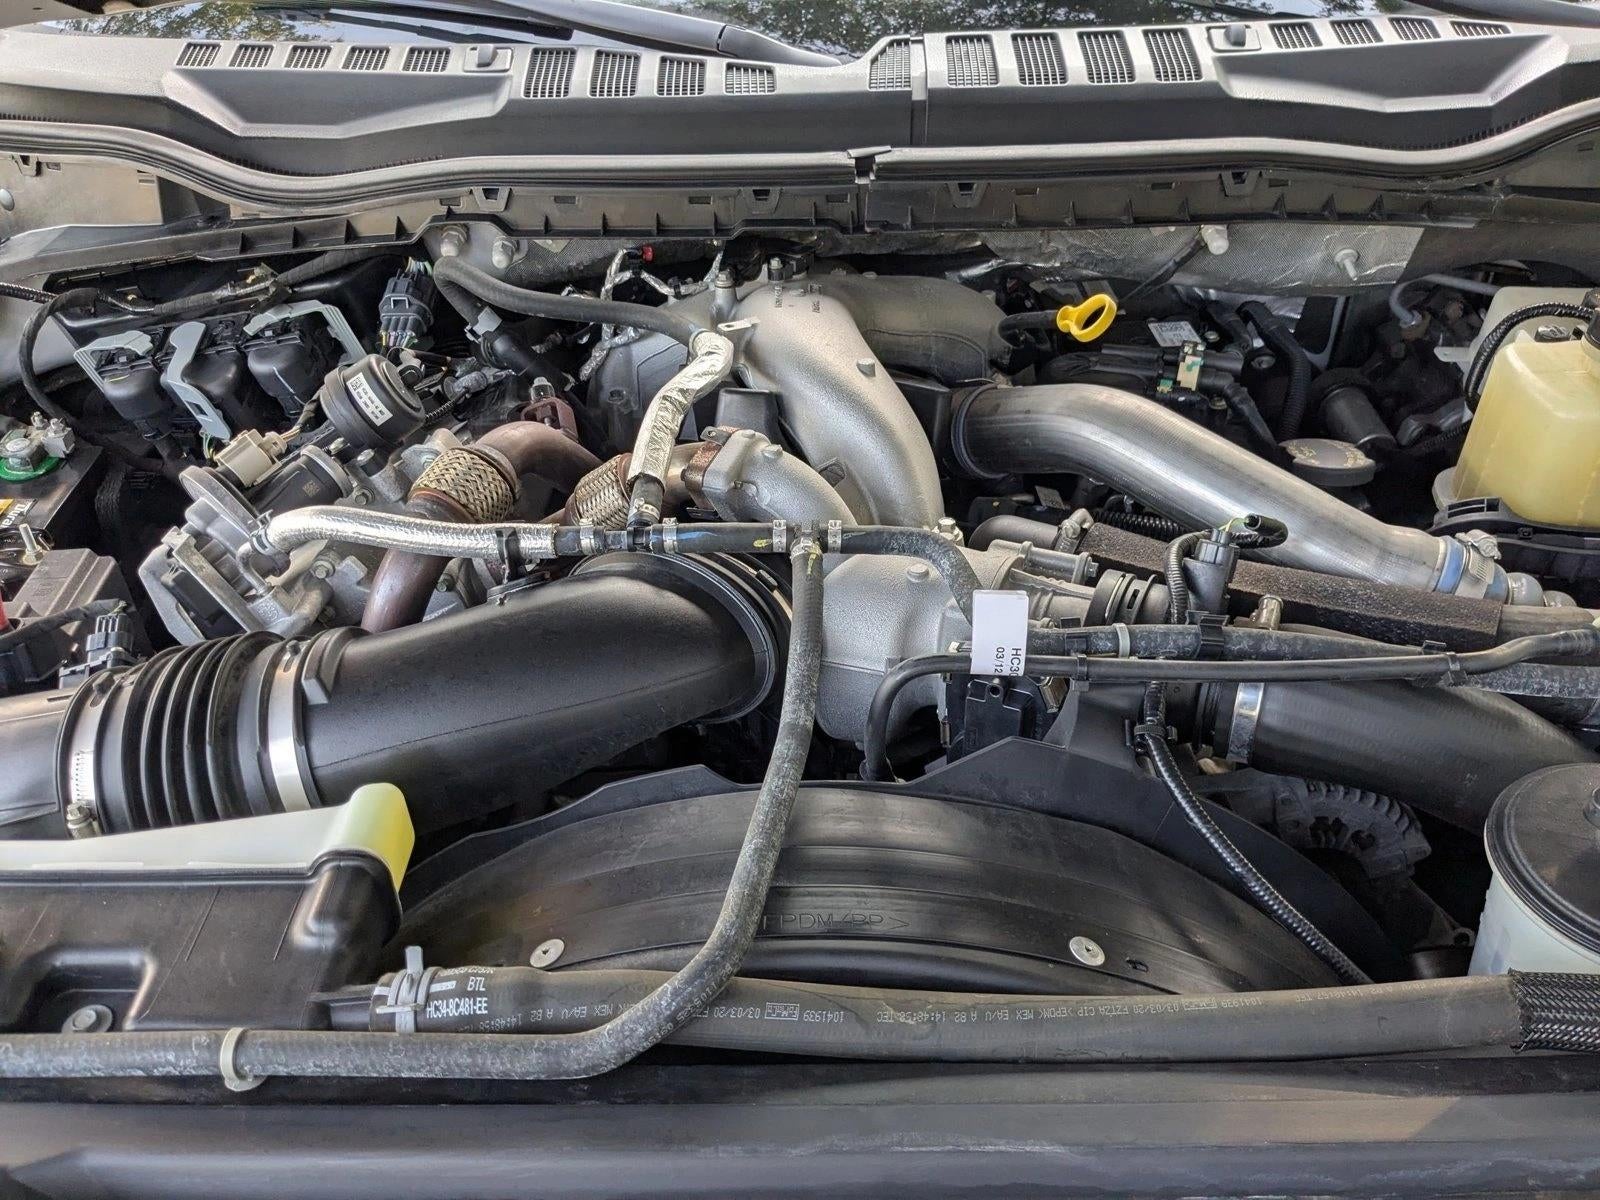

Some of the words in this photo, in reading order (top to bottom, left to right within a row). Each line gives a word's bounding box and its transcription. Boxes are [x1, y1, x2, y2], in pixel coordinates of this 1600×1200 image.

[994, 646, 1006, 674] 03/12
[466, 976, 486, 992] BTL
[713, 1006, 761, 1019] 03/03/20
[803, 1009, 844, 1023] 1041939
[1016, 1008, 1034, 1021] MEX
[1077, 1005, 1095, 1017] CIP
